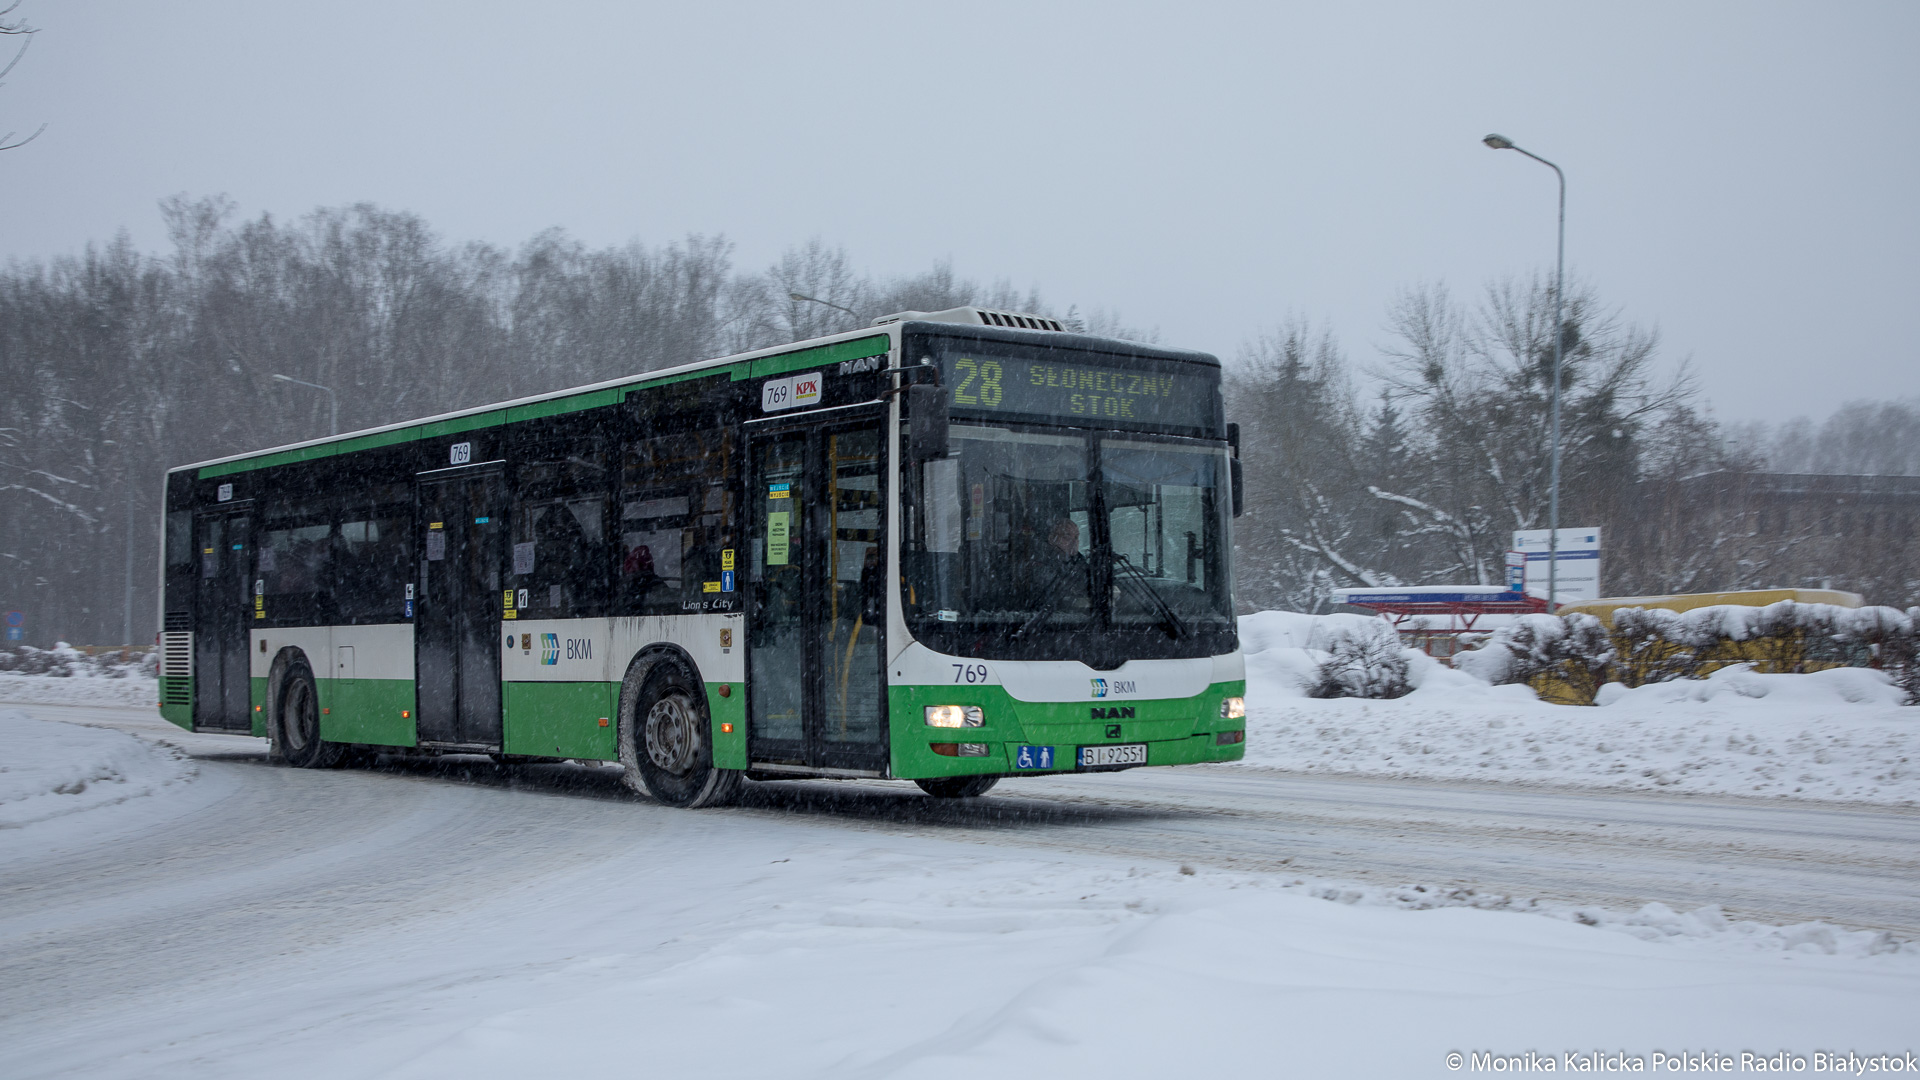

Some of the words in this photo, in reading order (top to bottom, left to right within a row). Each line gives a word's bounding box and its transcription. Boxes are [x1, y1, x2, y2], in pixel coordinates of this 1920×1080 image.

[839, 356, 880, 375] MAN
[796, 380, 818, 396] KPK
[955, 358, 1003, 407] 28
[1029, 365, 1173, 397] SŁONECZNY
[767, 385, 787, 405] 769
[1070, 394, 1135, 418] STOK
[453, 445, 468, 462] 769
[711, 598, 734, 611] City
[567, 638, 592, 660] BKM
[952, 664, 987, 683] 769
[1114, 681, 1136, 694] BKM
[1091, 706, 1135, 720] MAN
[1085, 749, 1102, 764] BI
[1107, 746, 1144, 763] 92551
